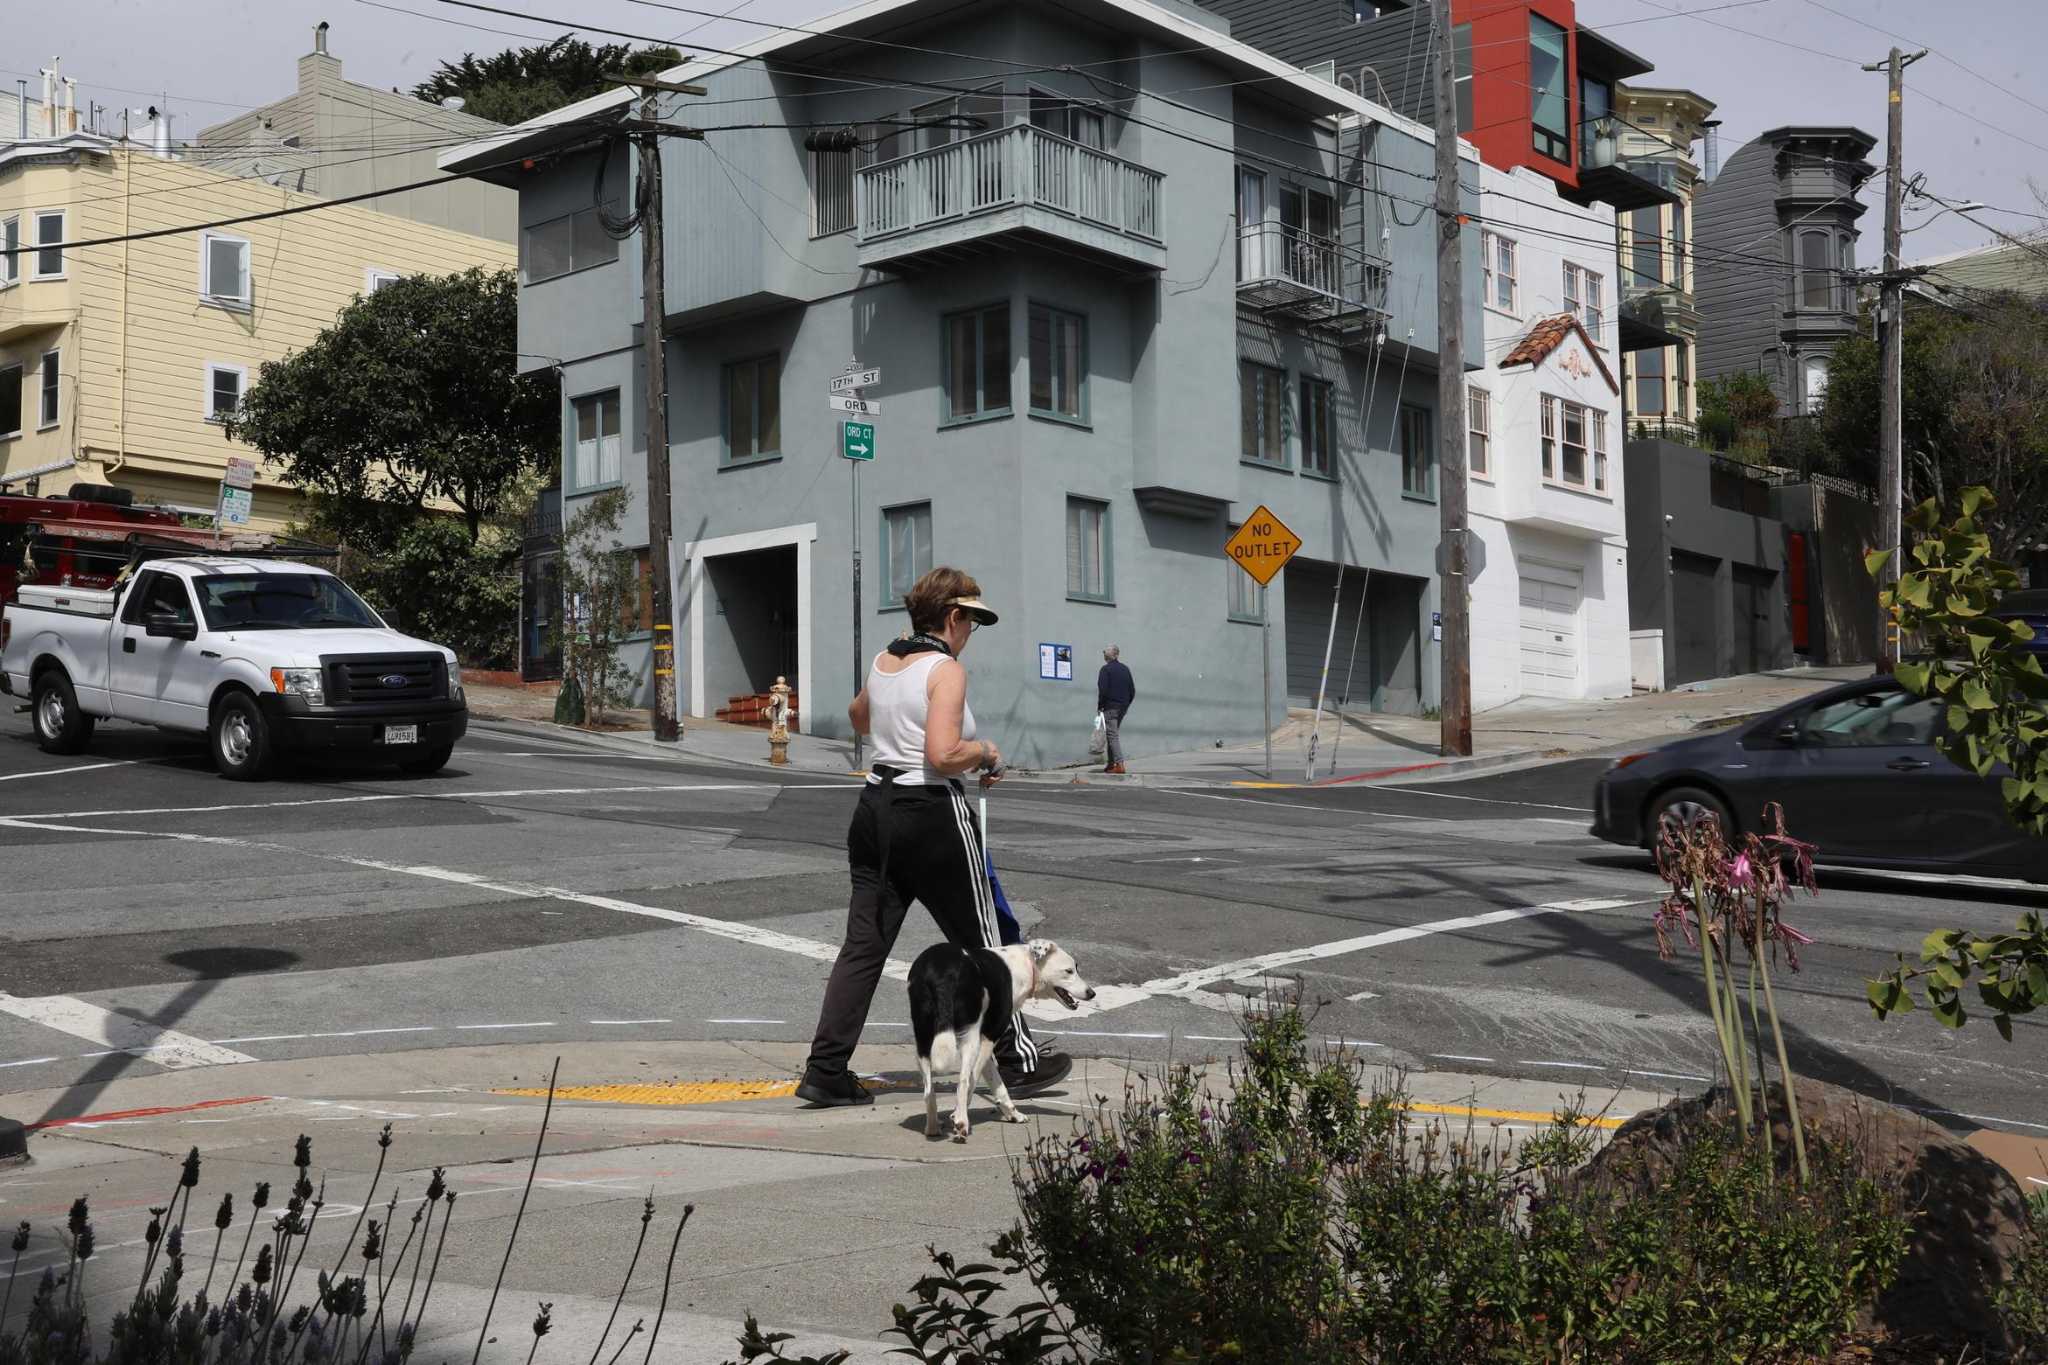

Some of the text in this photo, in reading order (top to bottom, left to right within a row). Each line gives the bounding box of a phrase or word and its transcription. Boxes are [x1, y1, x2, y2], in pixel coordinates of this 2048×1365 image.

[833, 372, 876, 389] 17TH ST
[845, 400, 867, 411] ORD
[847, 426, 873, 440] ORD CT
[1252, 523, 1272, 536] NO
[1234, 542, 1291, 558] OUTLET
